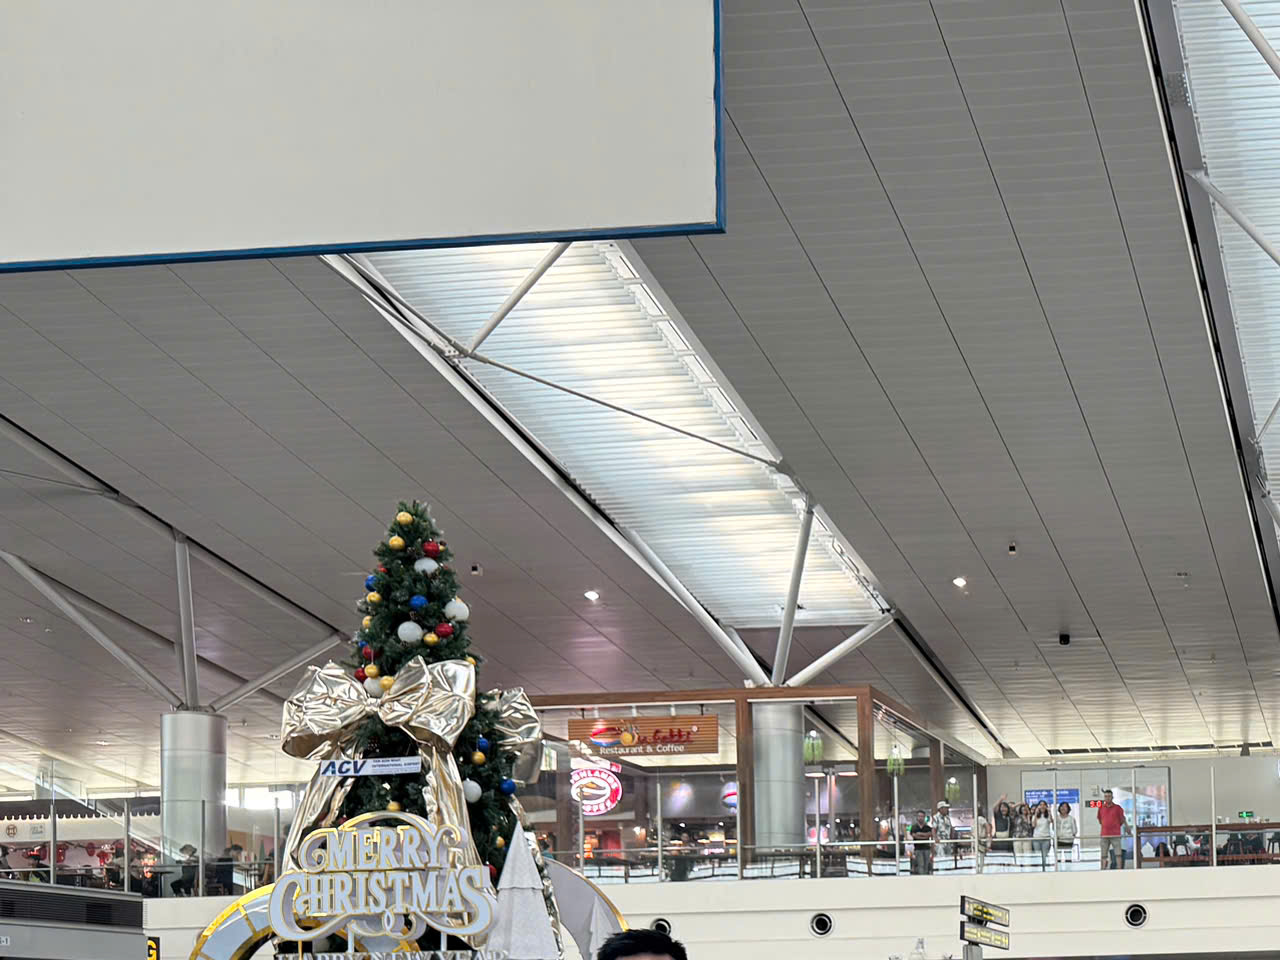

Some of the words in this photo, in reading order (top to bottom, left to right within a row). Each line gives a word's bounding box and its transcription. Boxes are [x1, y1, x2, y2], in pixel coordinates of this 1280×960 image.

[600, 746, 643, 754] Restaurant
[656, 744, 684, 752] Coffee
[321, 760, 367, 775] ACV
[300, 825, 466, 873] MERRY
[269, 866, 495, 941] CHRISTMAS
